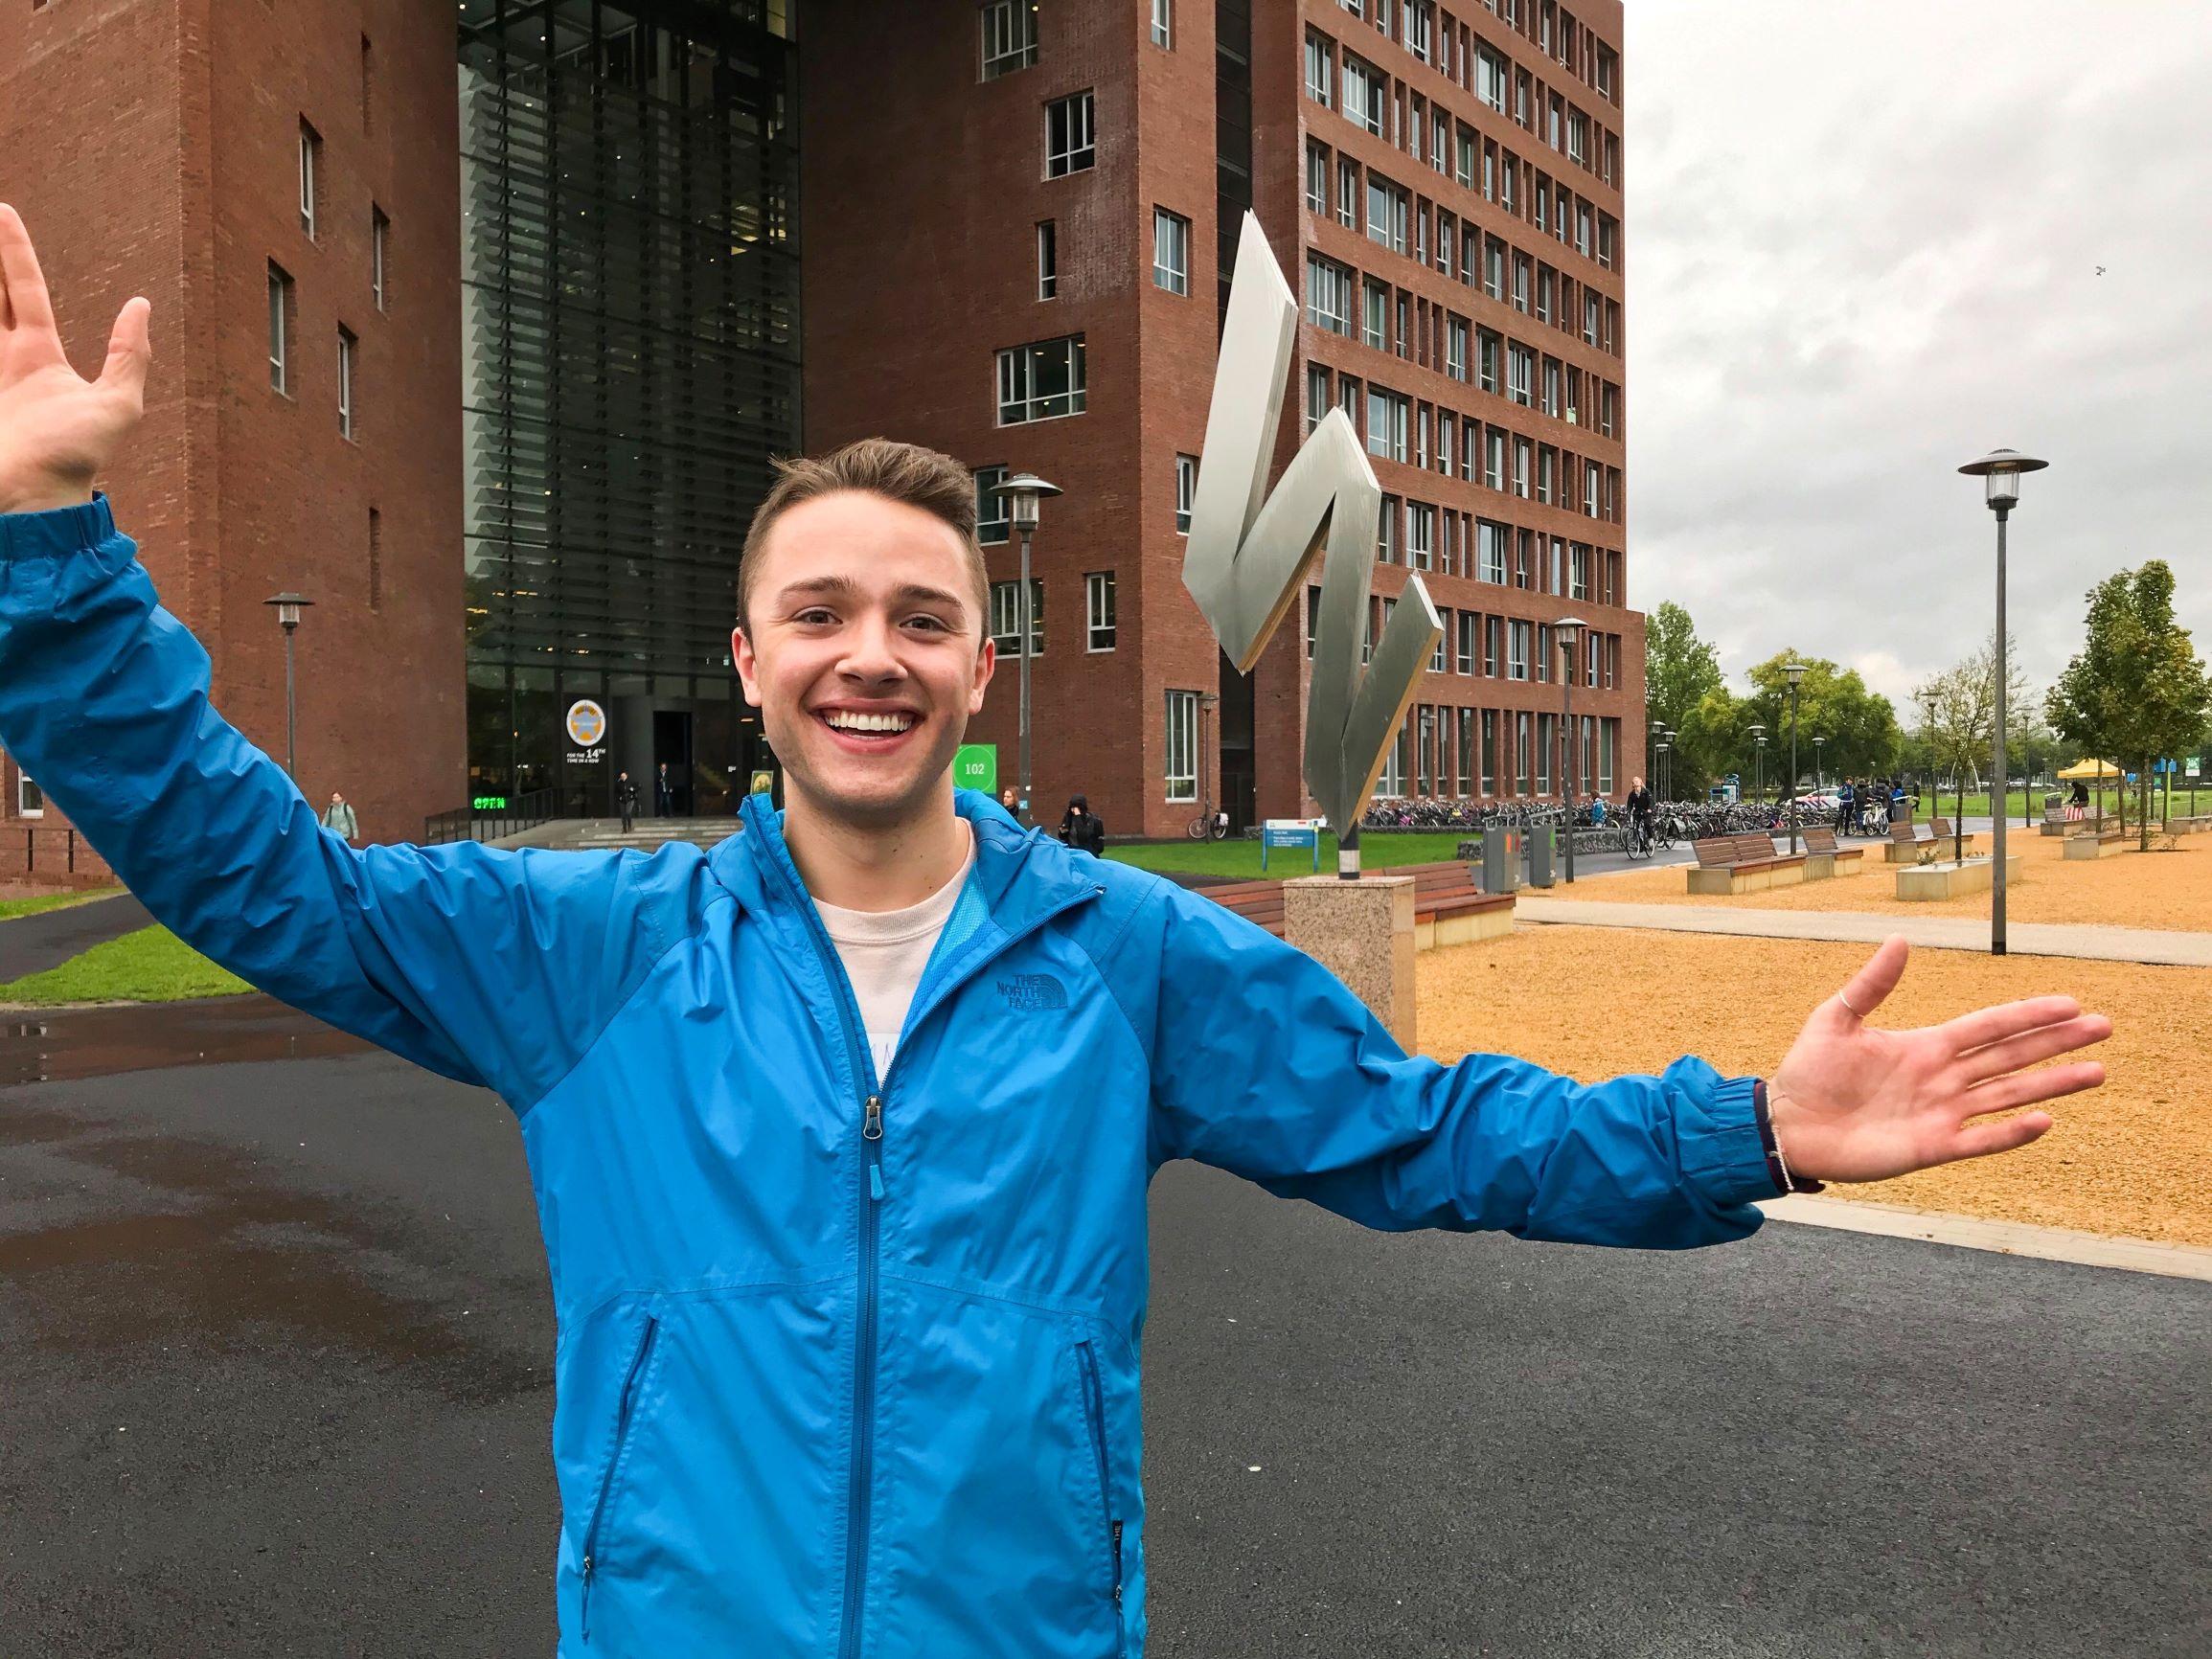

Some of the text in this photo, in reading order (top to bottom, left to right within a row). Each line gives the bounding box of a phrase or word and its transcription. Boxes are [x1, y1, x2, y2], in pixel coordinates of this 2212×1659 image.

[965, 763, 985, 775] 102
[1013, 973, 1041, 987] THE
[996, 981, 1041, 997] NORTH
[1009, 996, 1042, 1010] FACE
